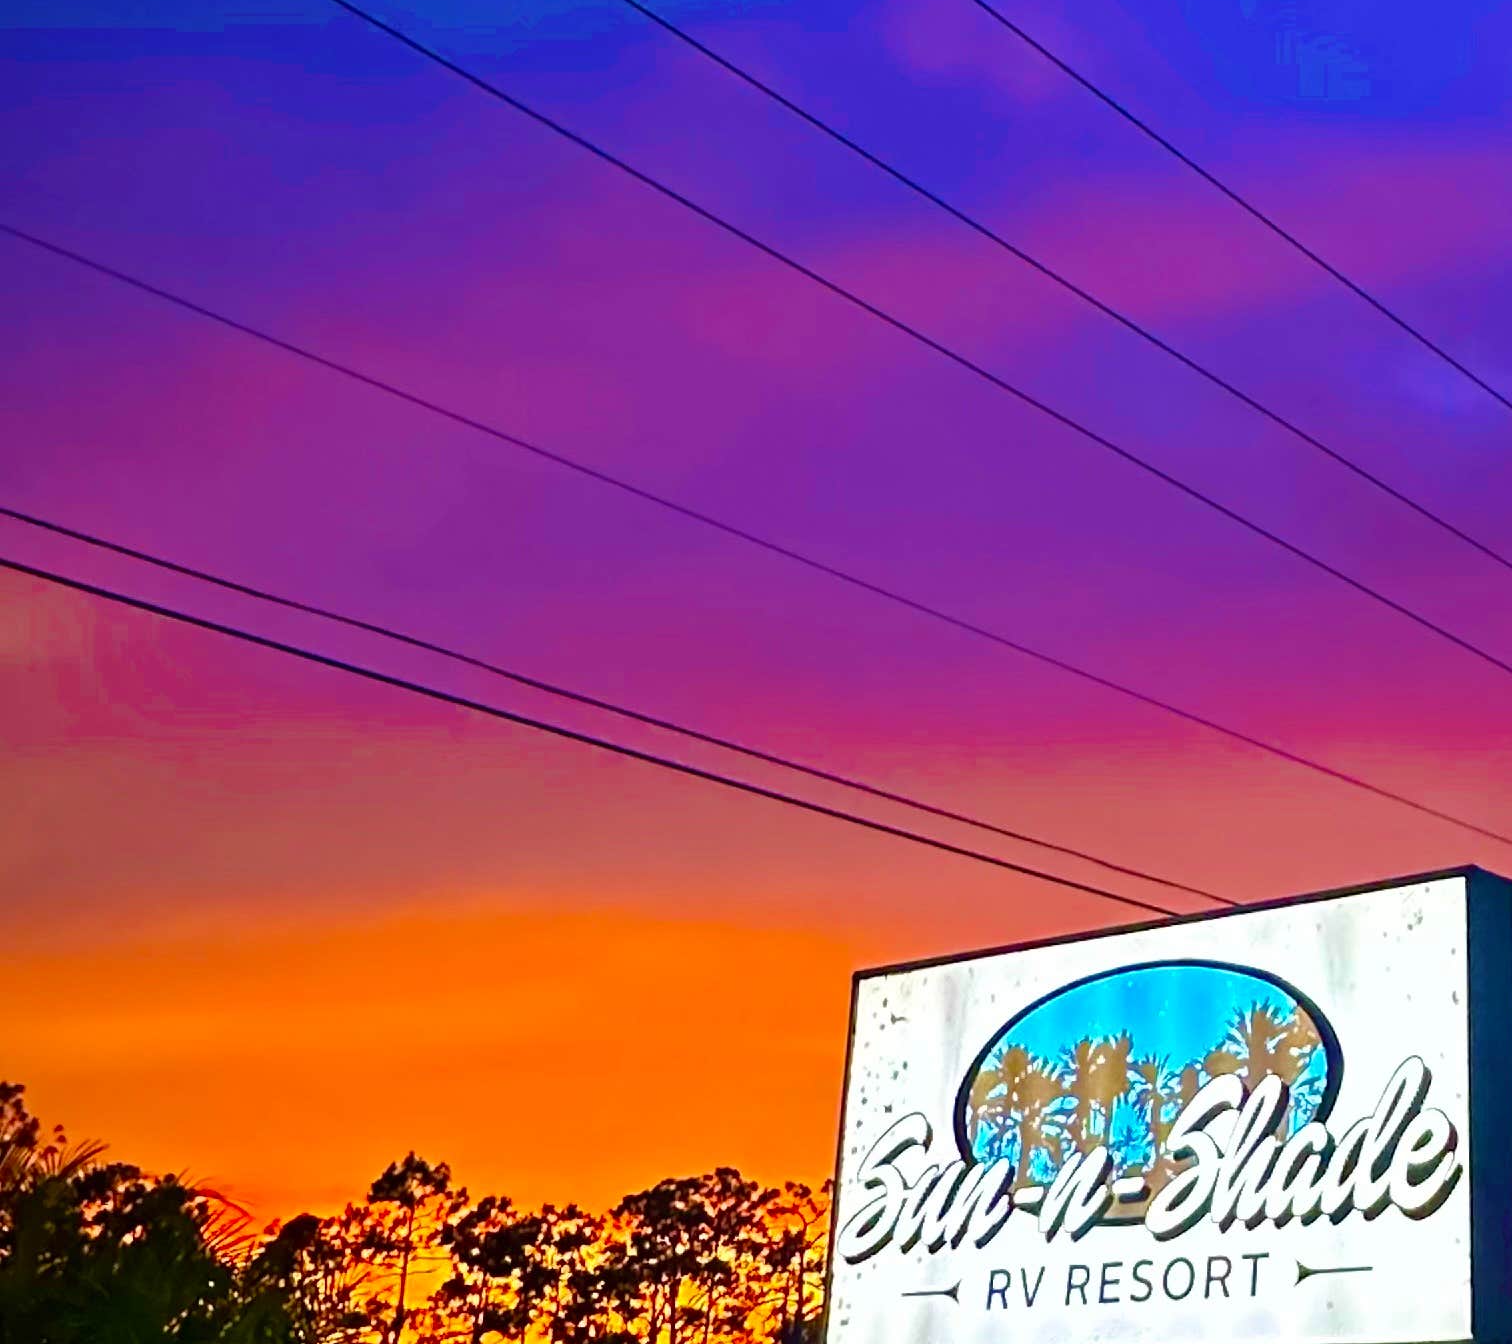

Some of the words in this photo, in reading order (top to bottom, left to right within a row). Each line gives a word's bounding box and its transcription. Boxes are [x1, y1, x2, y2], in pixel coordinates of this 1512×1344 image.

[837, 1054, 1464, 1264] Sun-n-Shade
[985, 1266, 1046, 1311] RV
[1064, 1252, 1270, 1307] RESORT
